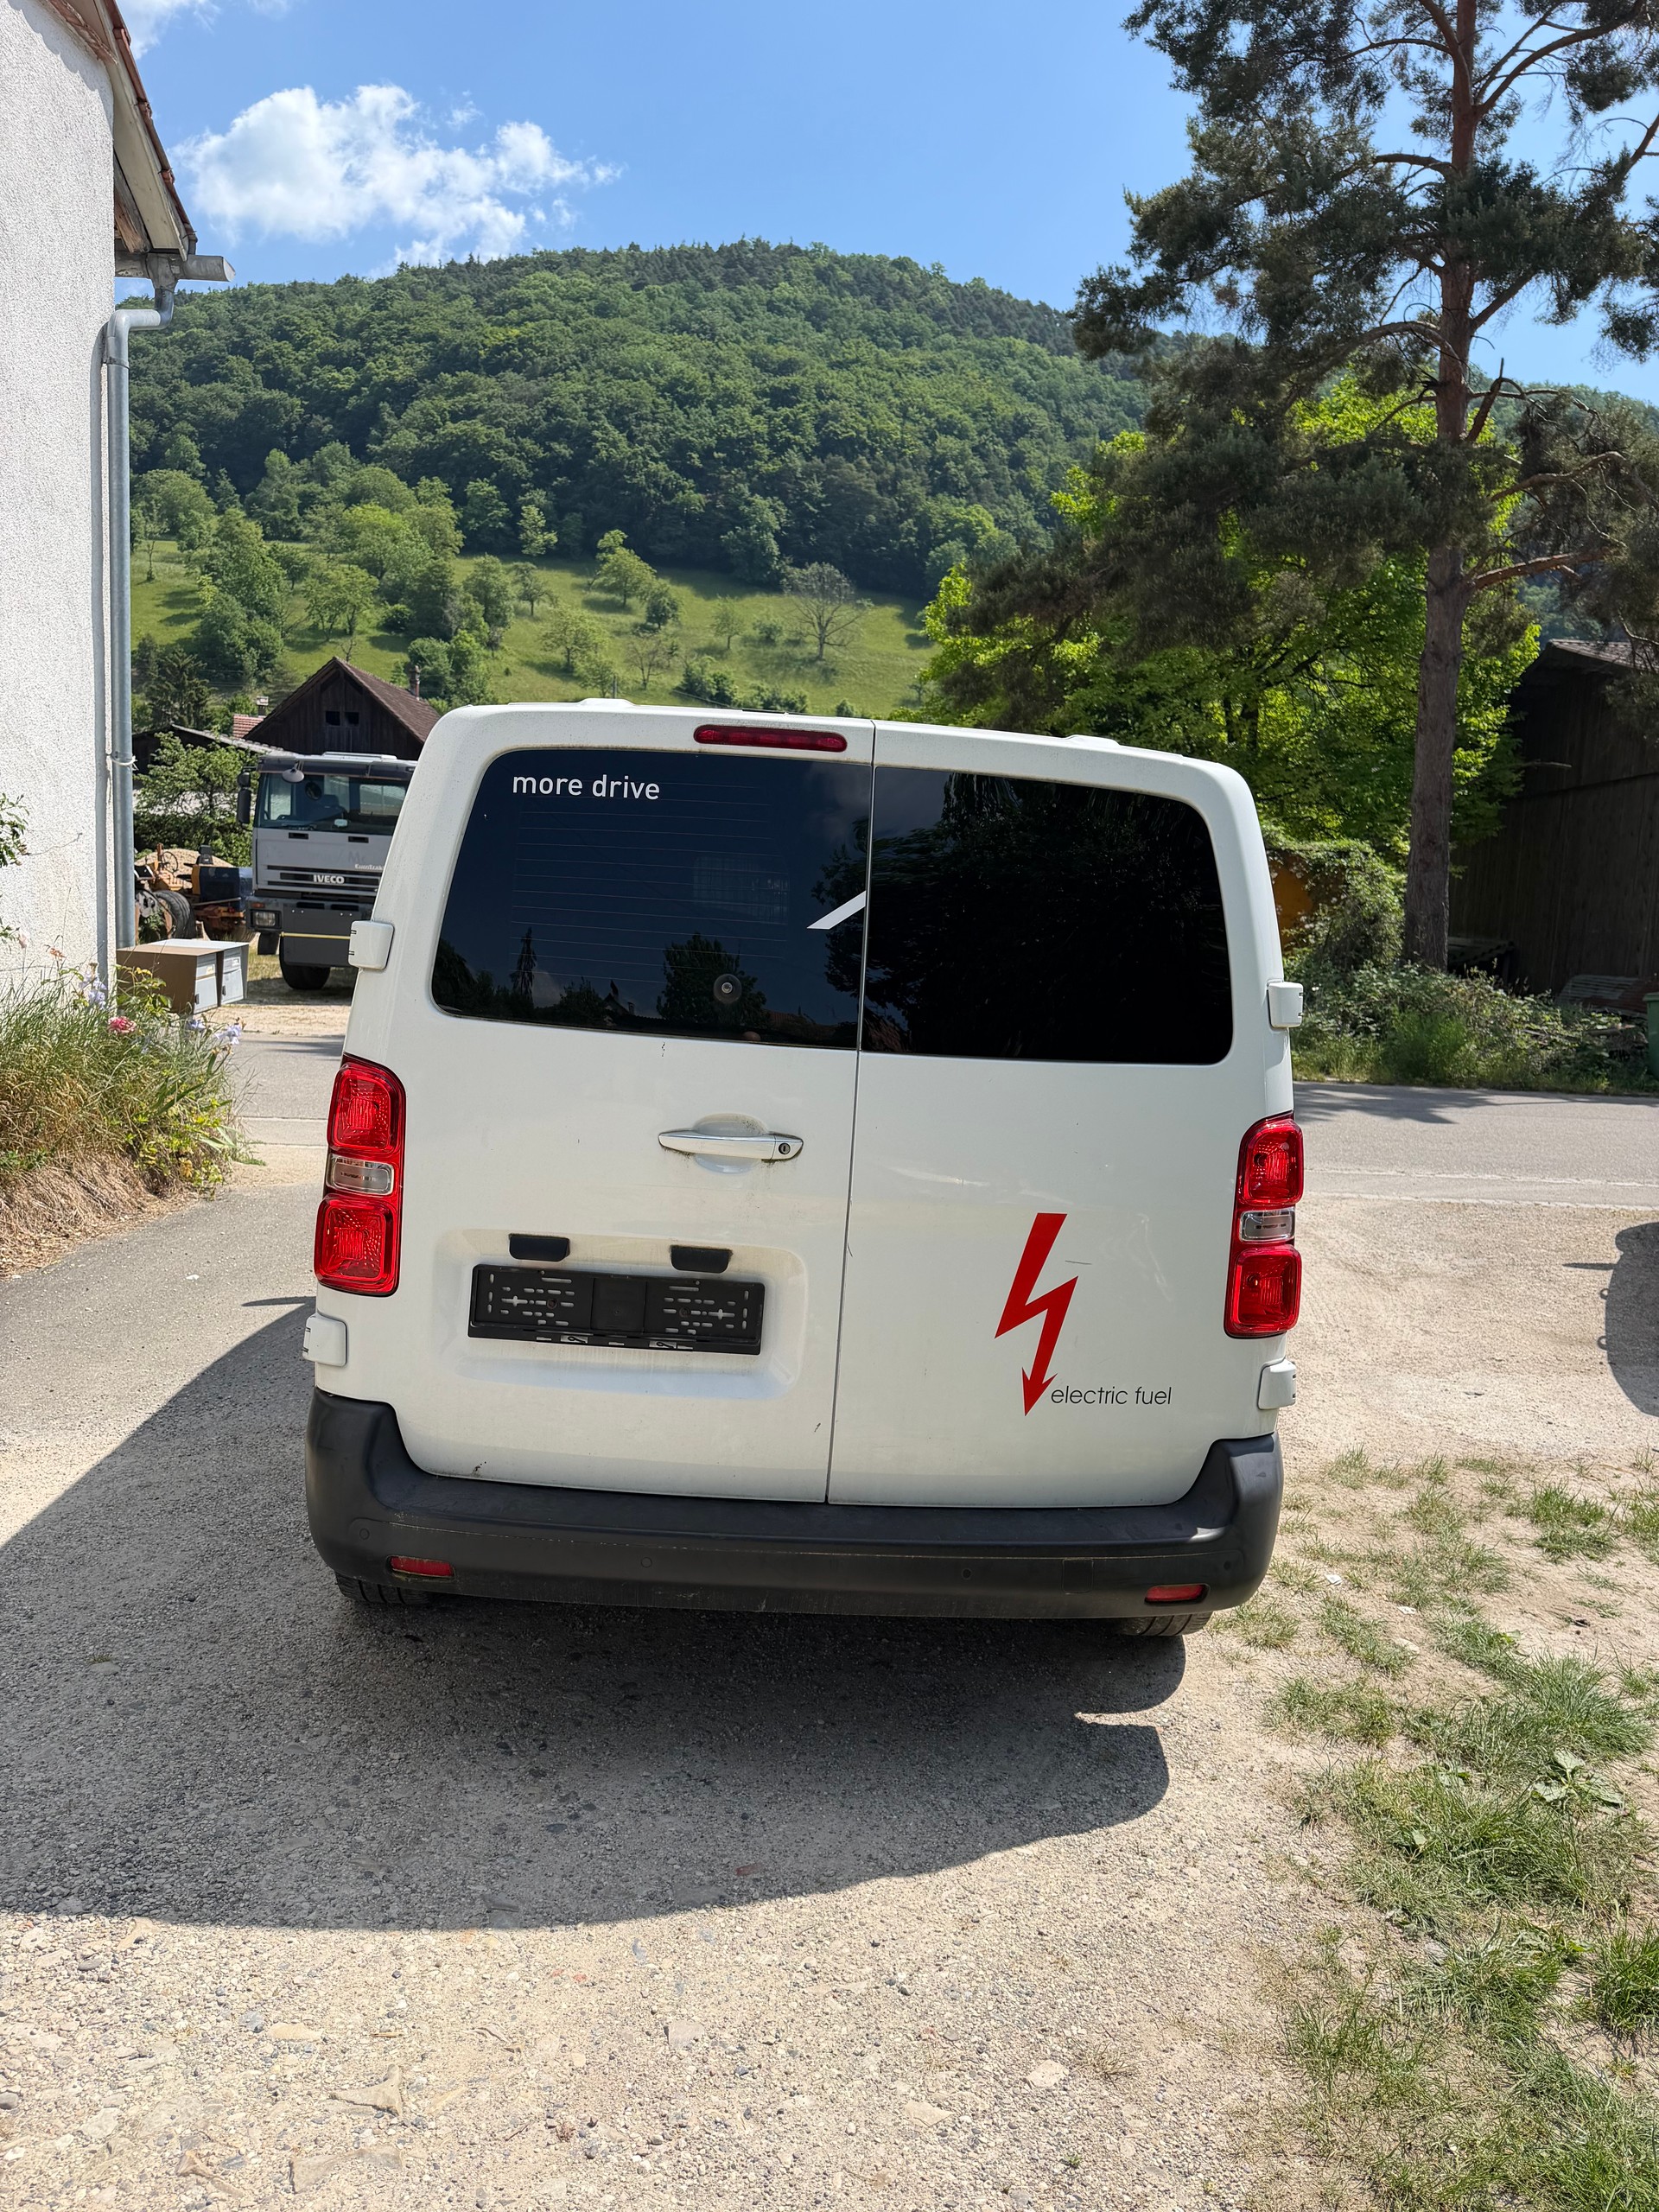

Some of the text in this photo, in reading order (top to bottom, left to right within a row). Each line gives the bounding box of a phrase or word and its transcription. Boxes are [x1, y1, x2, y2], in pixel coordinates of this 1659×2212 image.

[512, 774, 660, 800] more drive
[313, 874, 345, 884] IVECO
[1051, 1385, 1173, 1405] electric fuel
